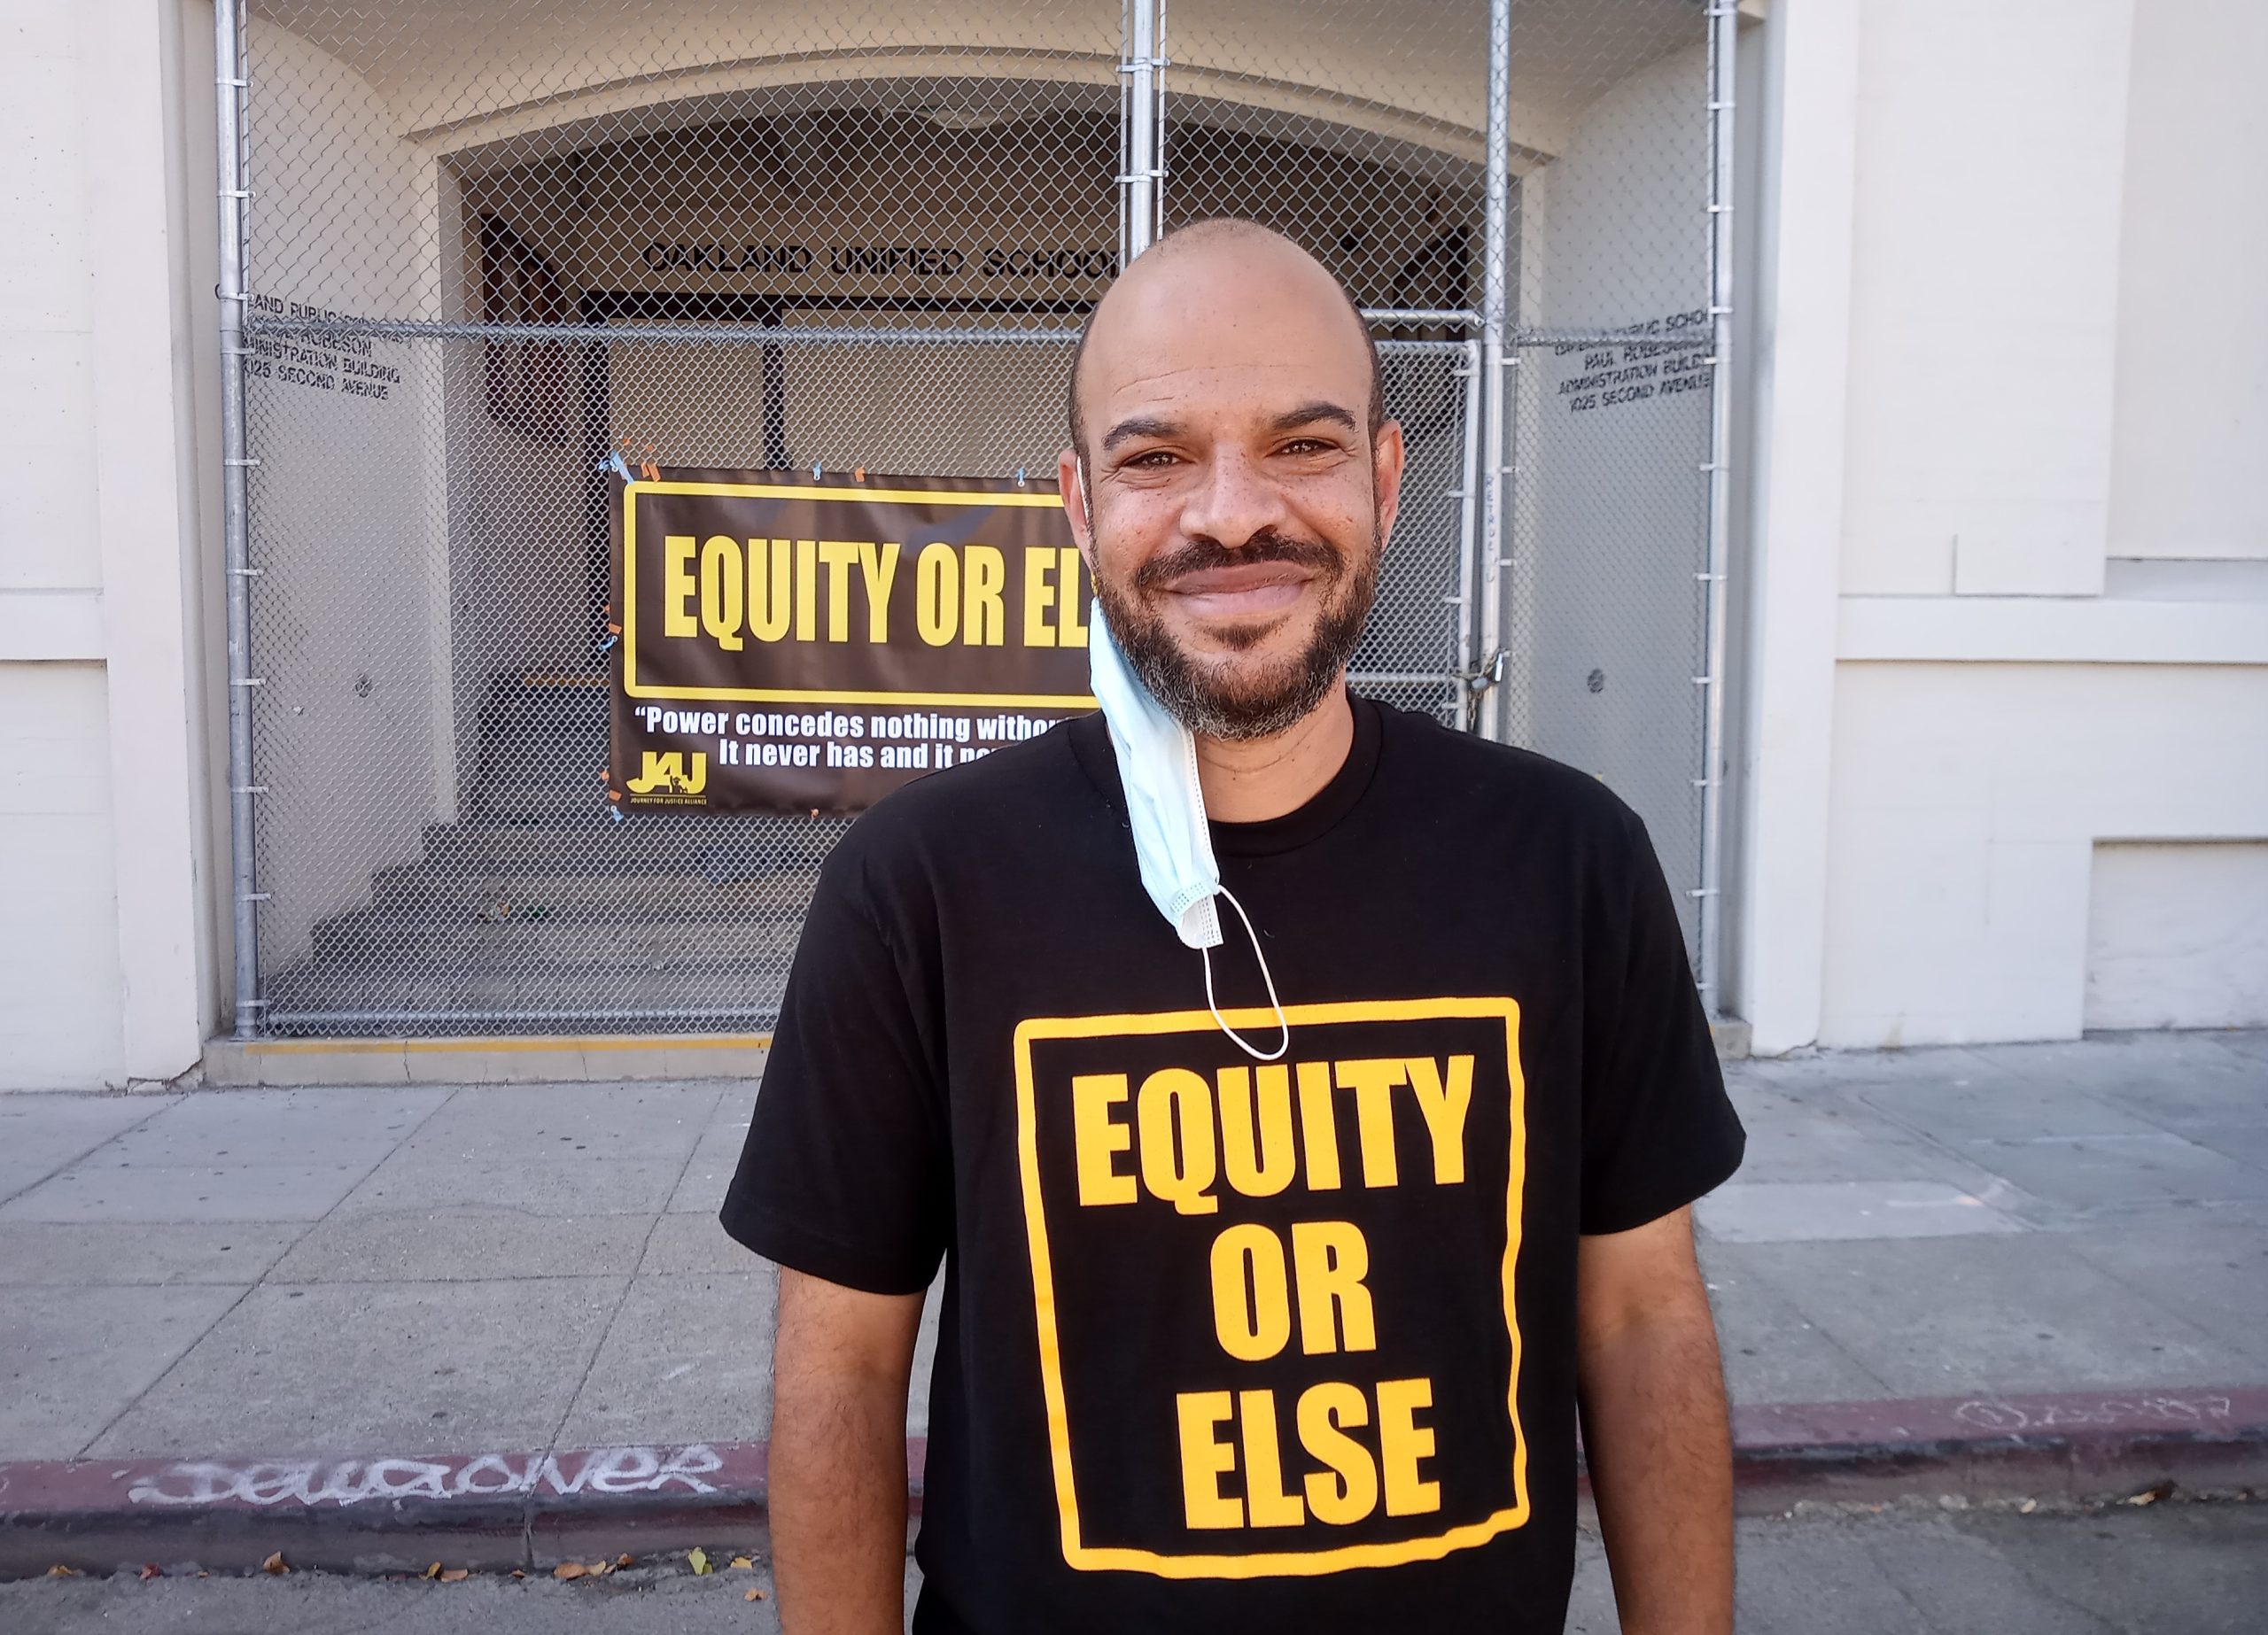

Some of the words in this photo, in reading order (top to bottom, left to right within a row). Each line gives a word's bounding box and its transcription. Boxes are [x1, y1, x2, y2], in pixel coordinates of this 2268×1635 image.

[641, 242, 813, 273] OAKLAND
[830, 246, 965, 275] UNIFIED
[277, 364, 336, 391] SECOND
[340, 377, 390, 401] AVENUE
[342, 357, 401, 384] BUILDING
[1601, 384, 1655, 407] SECOND
[1659, 372, 1711, 396] AVENUE
[664, 535, 901, 651] EQUITY
[916, 542, 1005, 647] OR
[1023, 546, 1099, 648] EL
[735, 710, 865, 739] concedes
[870, 713, 971, 743] nothing
[718, 738, 739, 765] It
[745, 741, 820, 769] never
[827, 741, 874, 769] has
[880, 743, 928, 769] and
[935, 743, 954, 769] it
[1072, 1055, 1475, 1215] EQUITY
[1210, 1221, 1377, 1361] OR
[1176, 1377, 1441, 1530] ELSE
